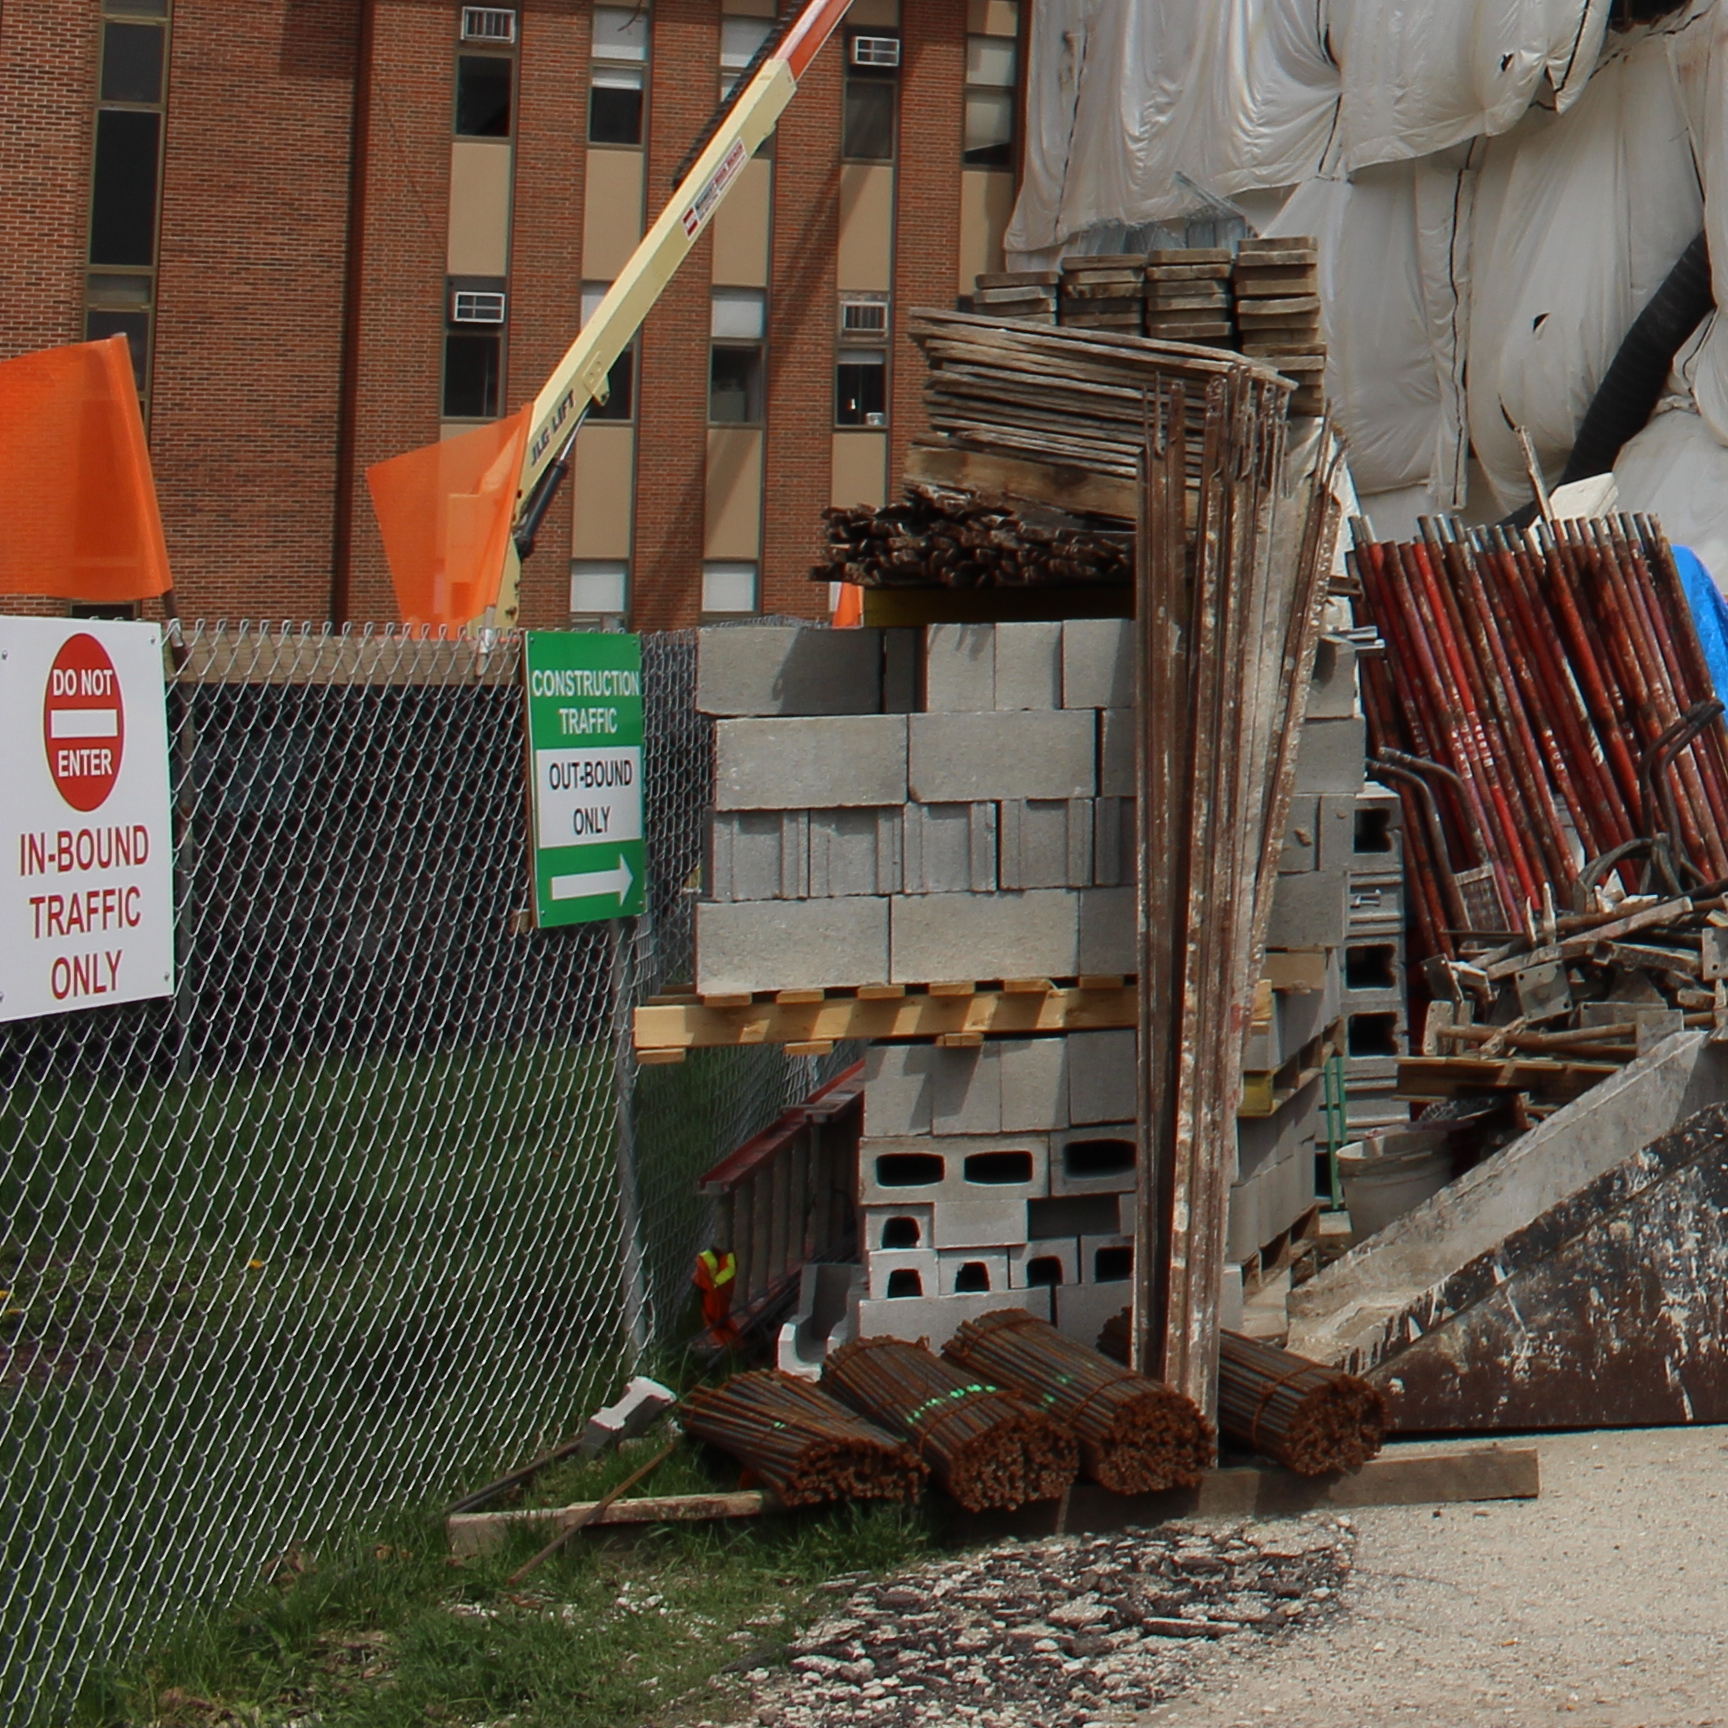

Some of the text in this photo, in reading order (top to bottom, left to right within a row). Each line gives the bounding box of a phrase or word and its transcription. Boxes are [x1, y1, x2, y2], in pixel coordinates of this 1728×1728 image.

[551, 389, 575, 434] LIFT
[52, 669, 113, 697] DO NOT
[532, 669, 640, 697] CONSTRUCTION
[558, 707, 618, 735] TRAFFIC
[57, 748, 113, 778] ENTER
[549, 759, 633, 791] OUT-BOUND
[573, 805, 611, 836] ONLY
[19, 824, 150, 877] IN-BOUND
[30, 885, 141, 939] TRAFFIC
[51, 949, 123, 1001] ONLY
